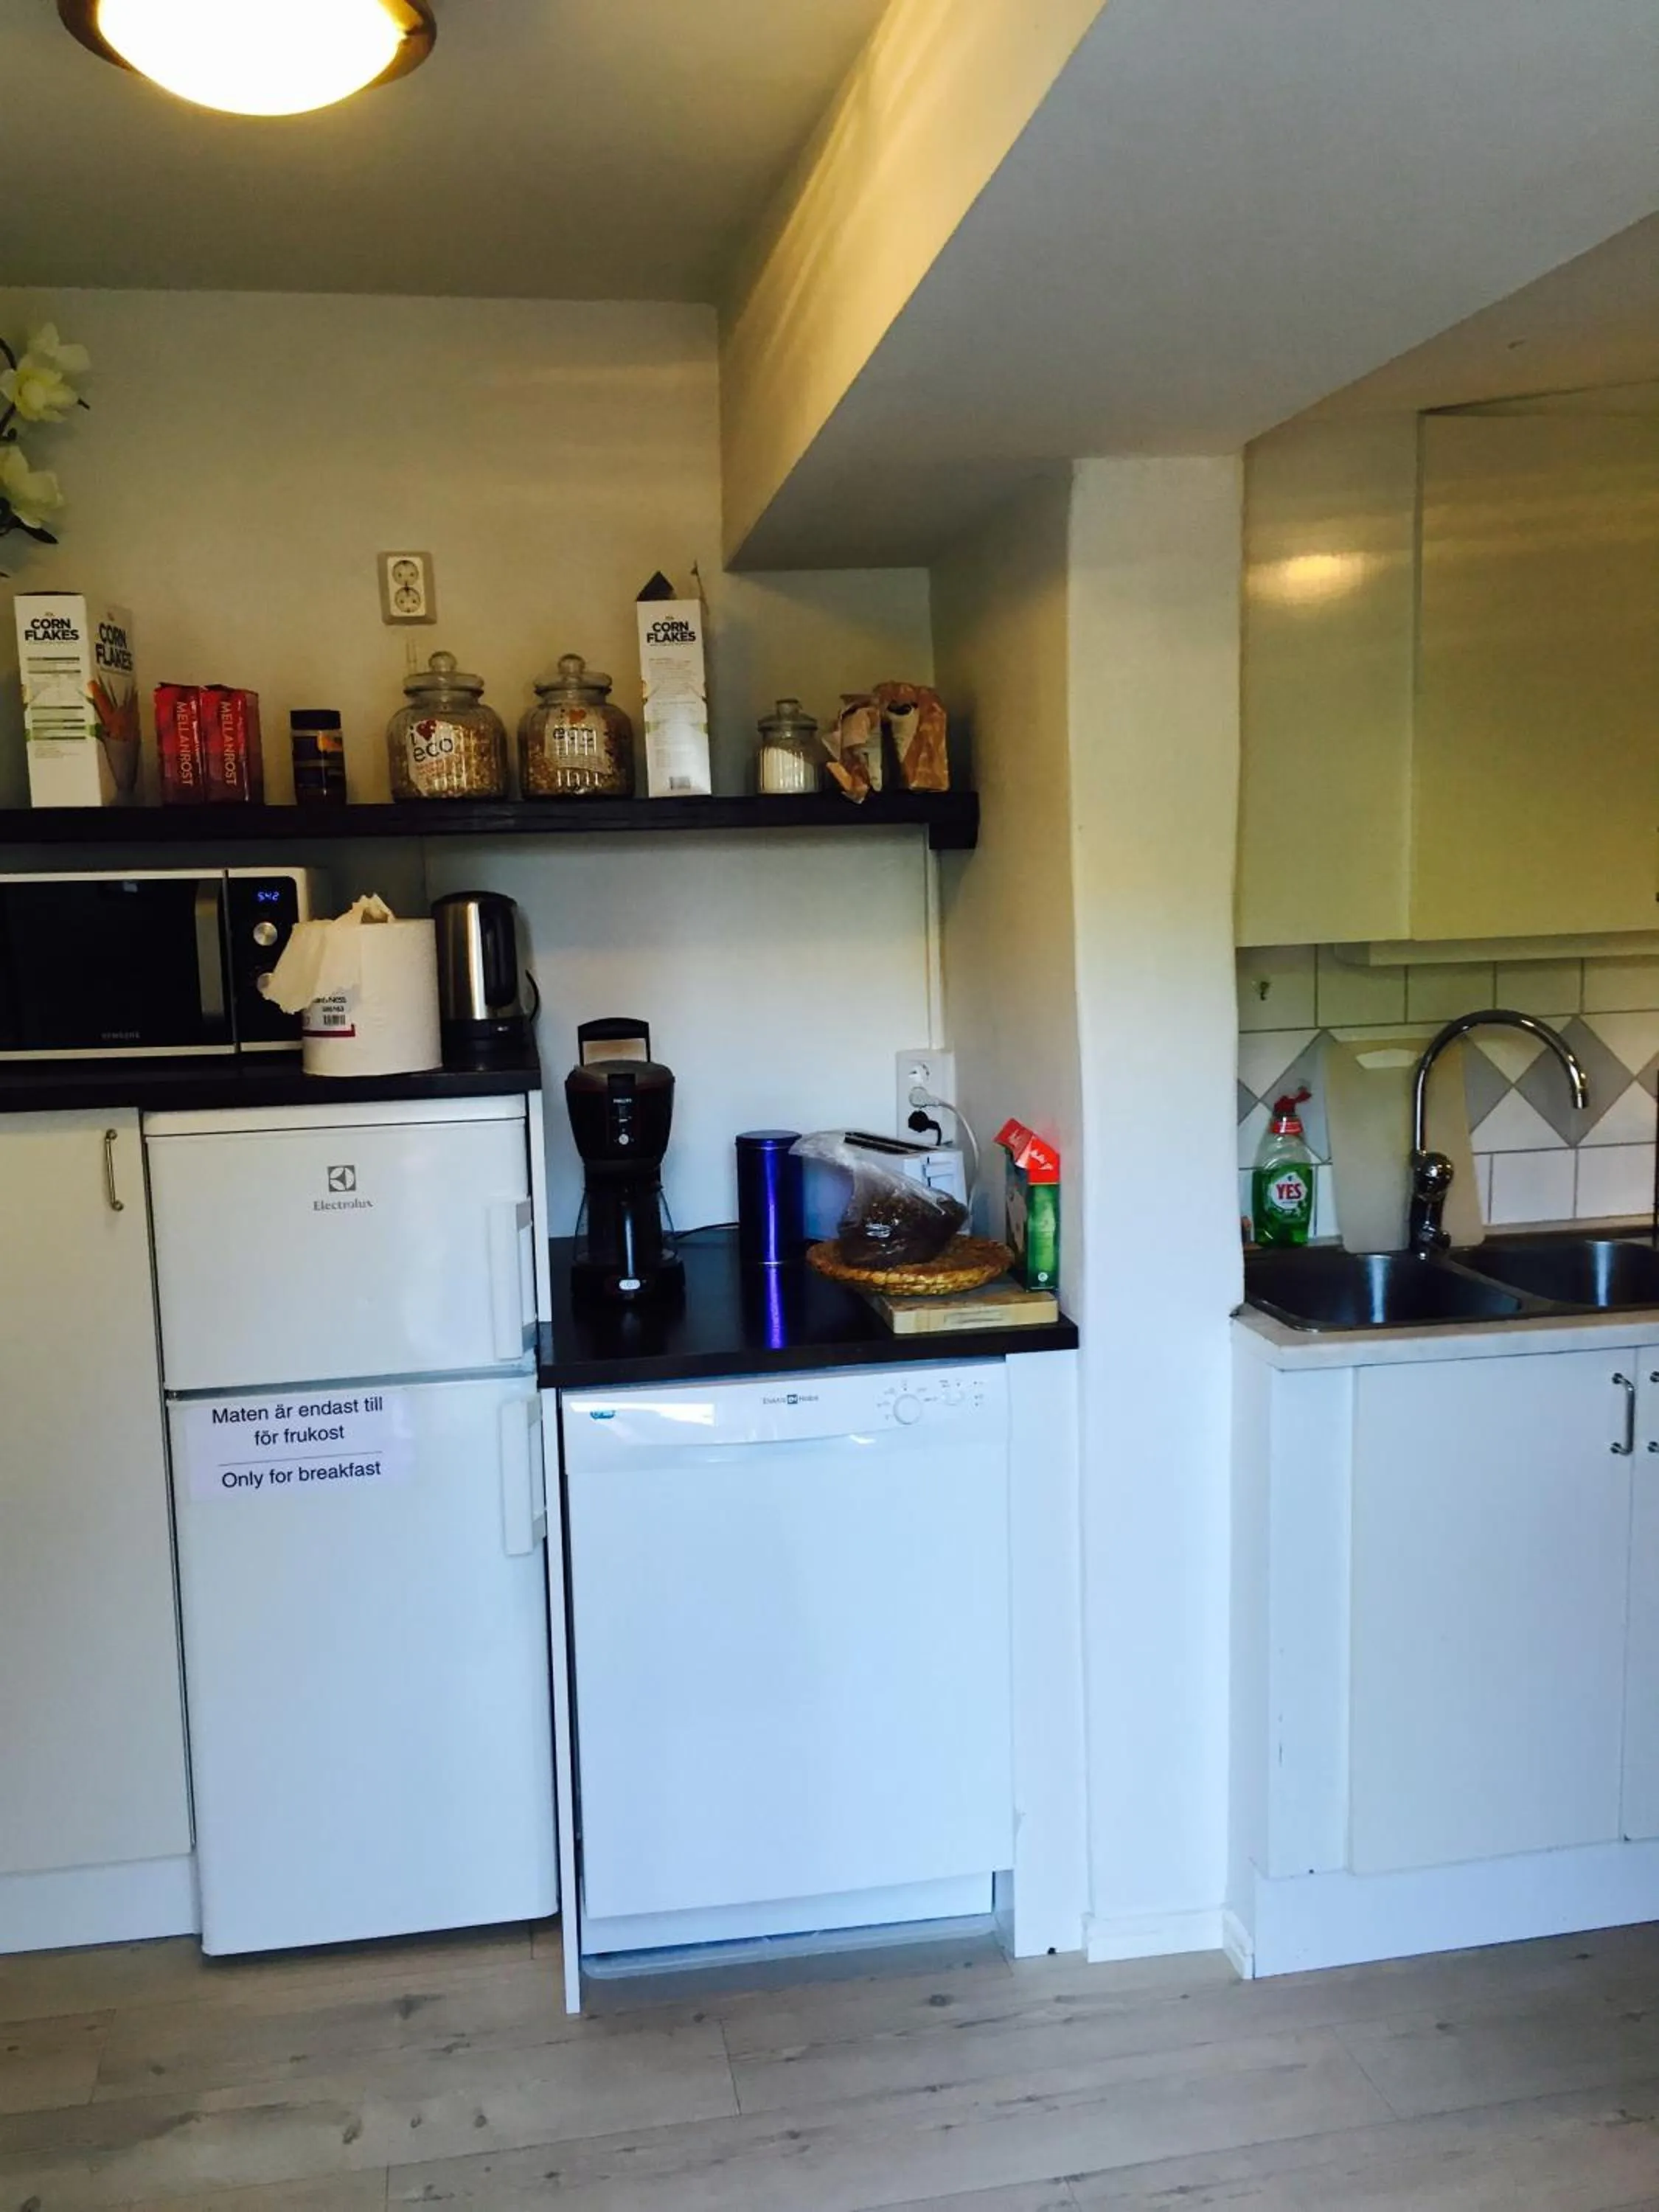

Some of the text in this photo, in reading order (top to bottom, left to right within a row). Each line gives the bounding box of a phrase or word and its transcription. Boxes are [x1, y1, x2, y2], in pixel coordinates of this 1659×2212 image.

[30, 618, 72, 629] CORN
[652, 621, 689, 632] CORN
[24, 629, 80, 641] FLAKES
[99, 622, 128, 649] CORN
[646, 631, 696, 643] FLAKES
[96, 643, 133, 672] FLAKES
[413, 738, 453, 762] eco
[1276, 1183, 1302, 1200] YES
[313, 1197, 374, 1211] Electrolux
[212, 1396, 383, 1424] Maten är endast till
[254, 1425, 345, 1446] för frukost
[221, 1461, 382, 1489] Only for breakfast
